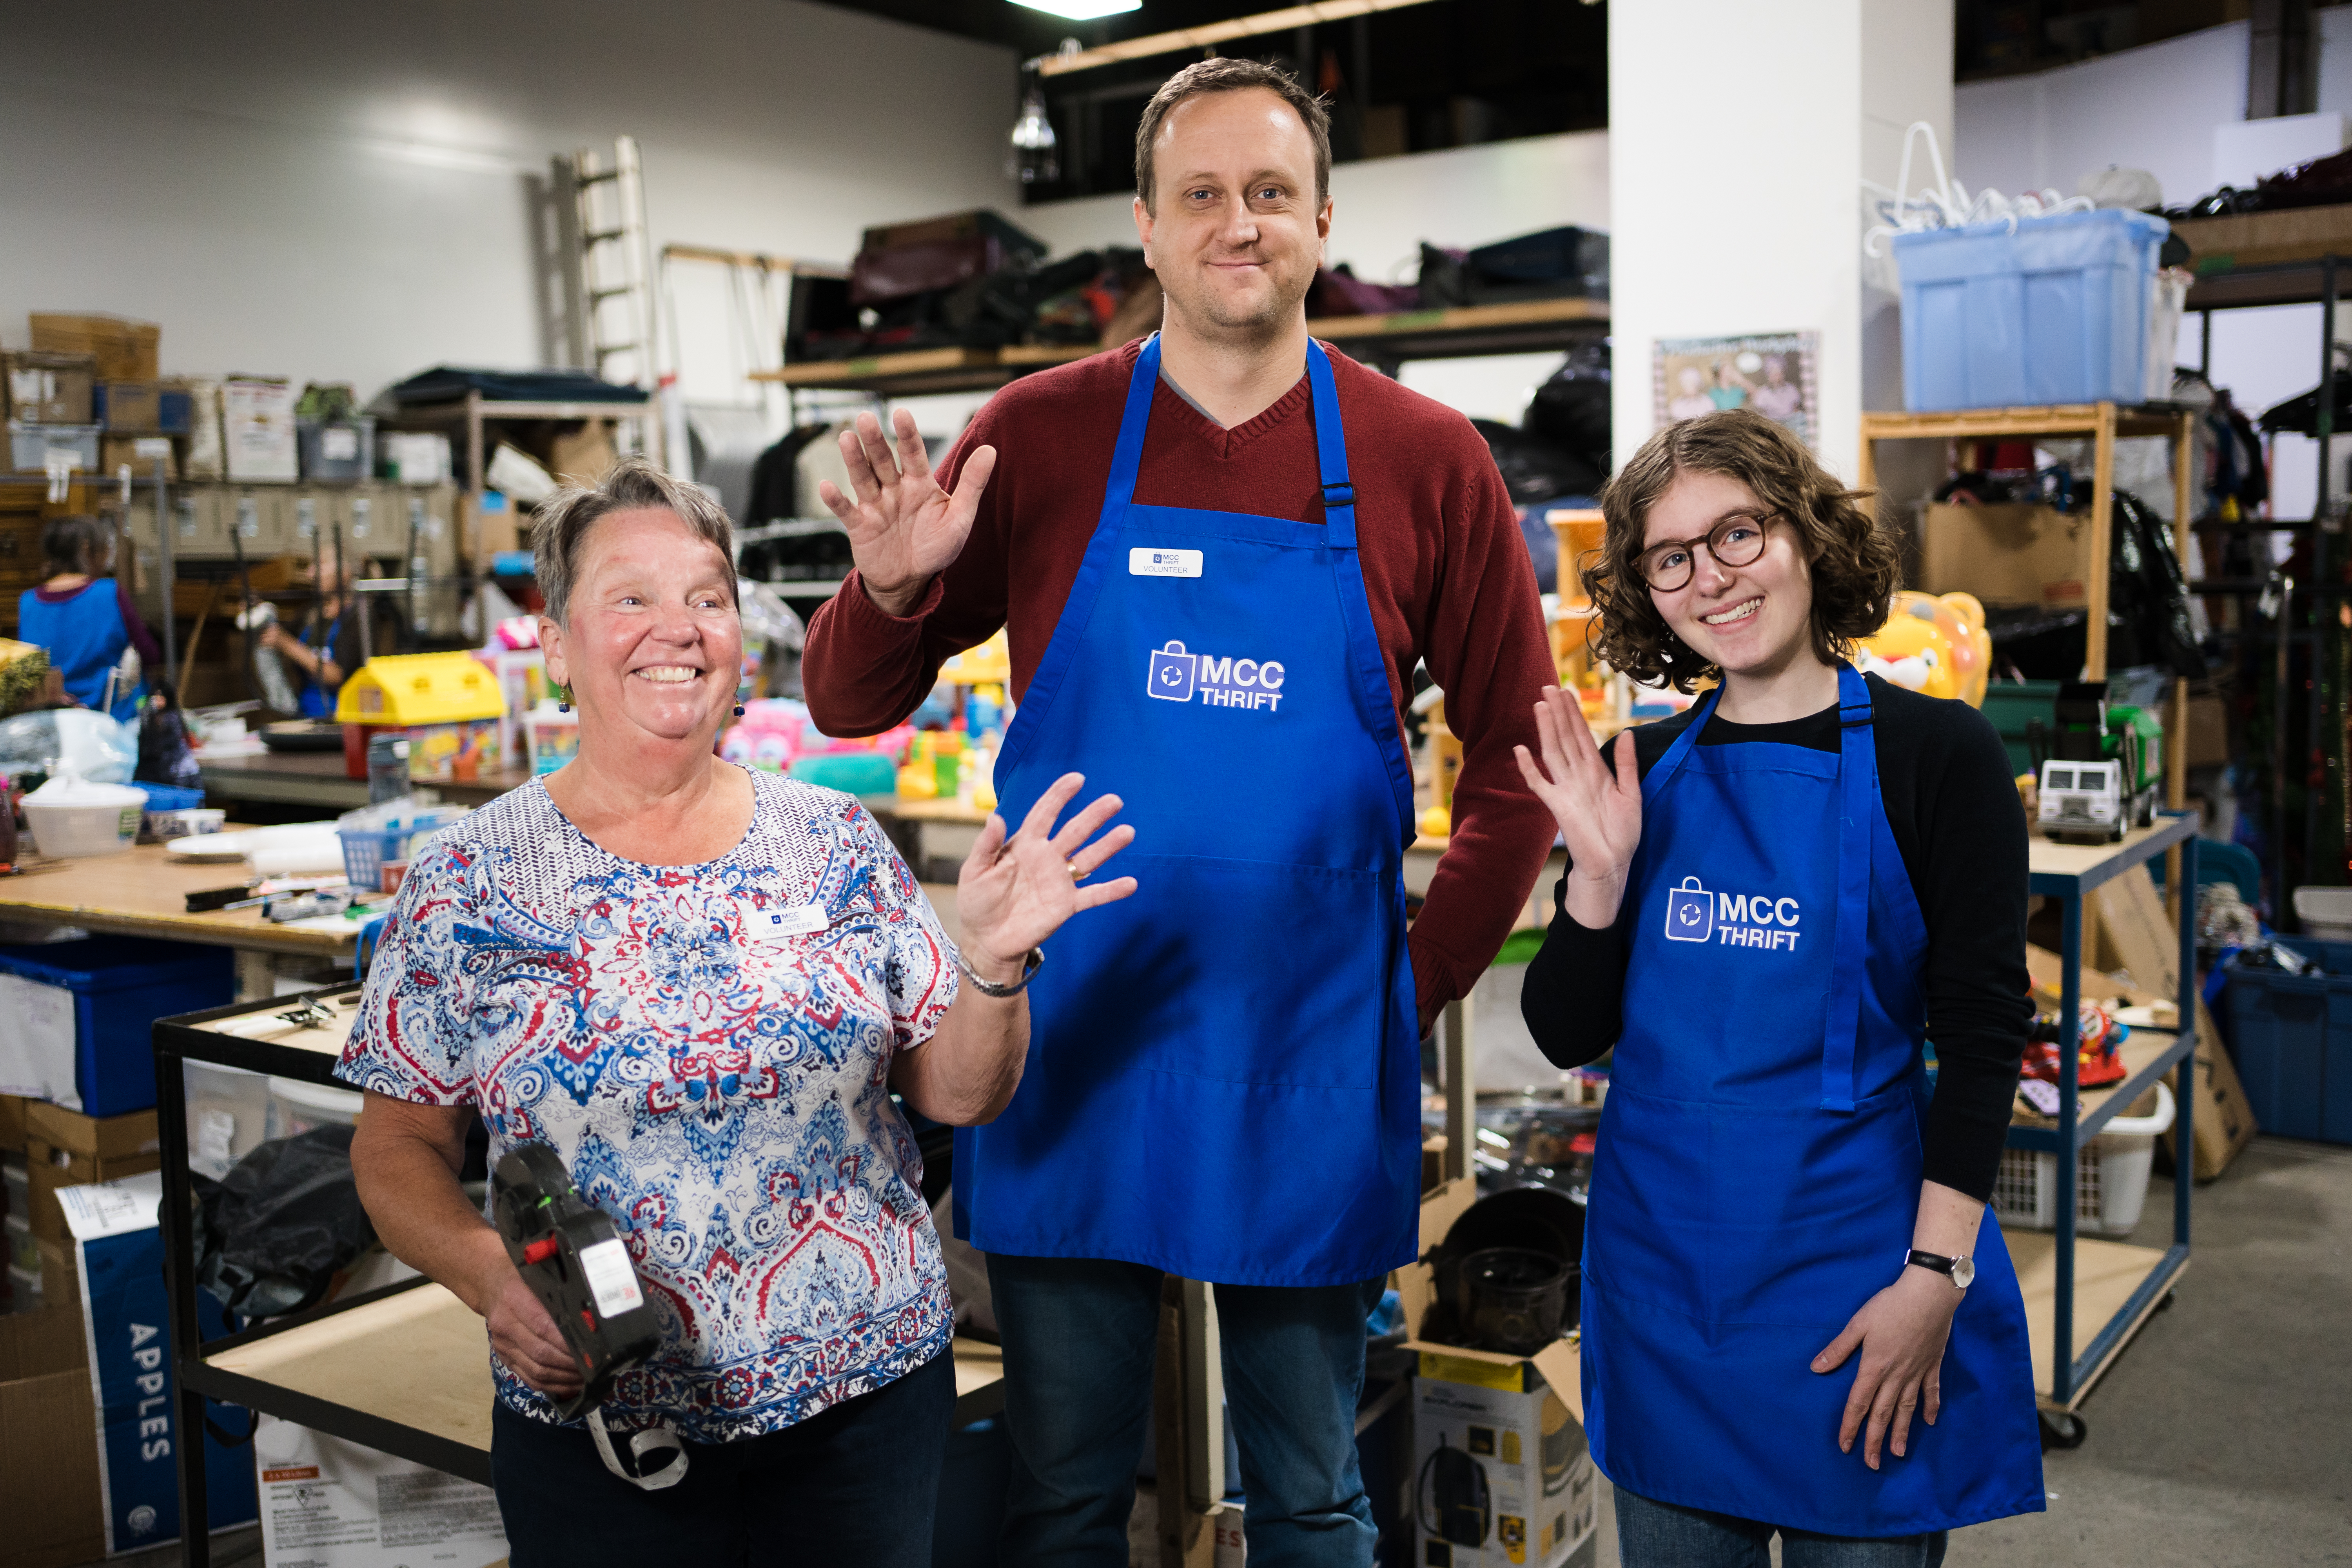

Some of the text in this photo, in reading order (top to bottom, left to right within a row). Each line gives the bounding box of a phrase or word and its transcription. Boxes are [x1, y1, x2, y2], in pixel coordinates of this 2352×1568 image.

[1200, 655, 1285, 689] MCC
[1200, 687, 1283, 711] THRIFT
[1719, 892, 1800, 927] MCC
[764, 922, 813, 934] VOLUNTEER
[1718, 926, 1800, 951] THRIFT
[129, 1323, 171, 1463] APPLES
